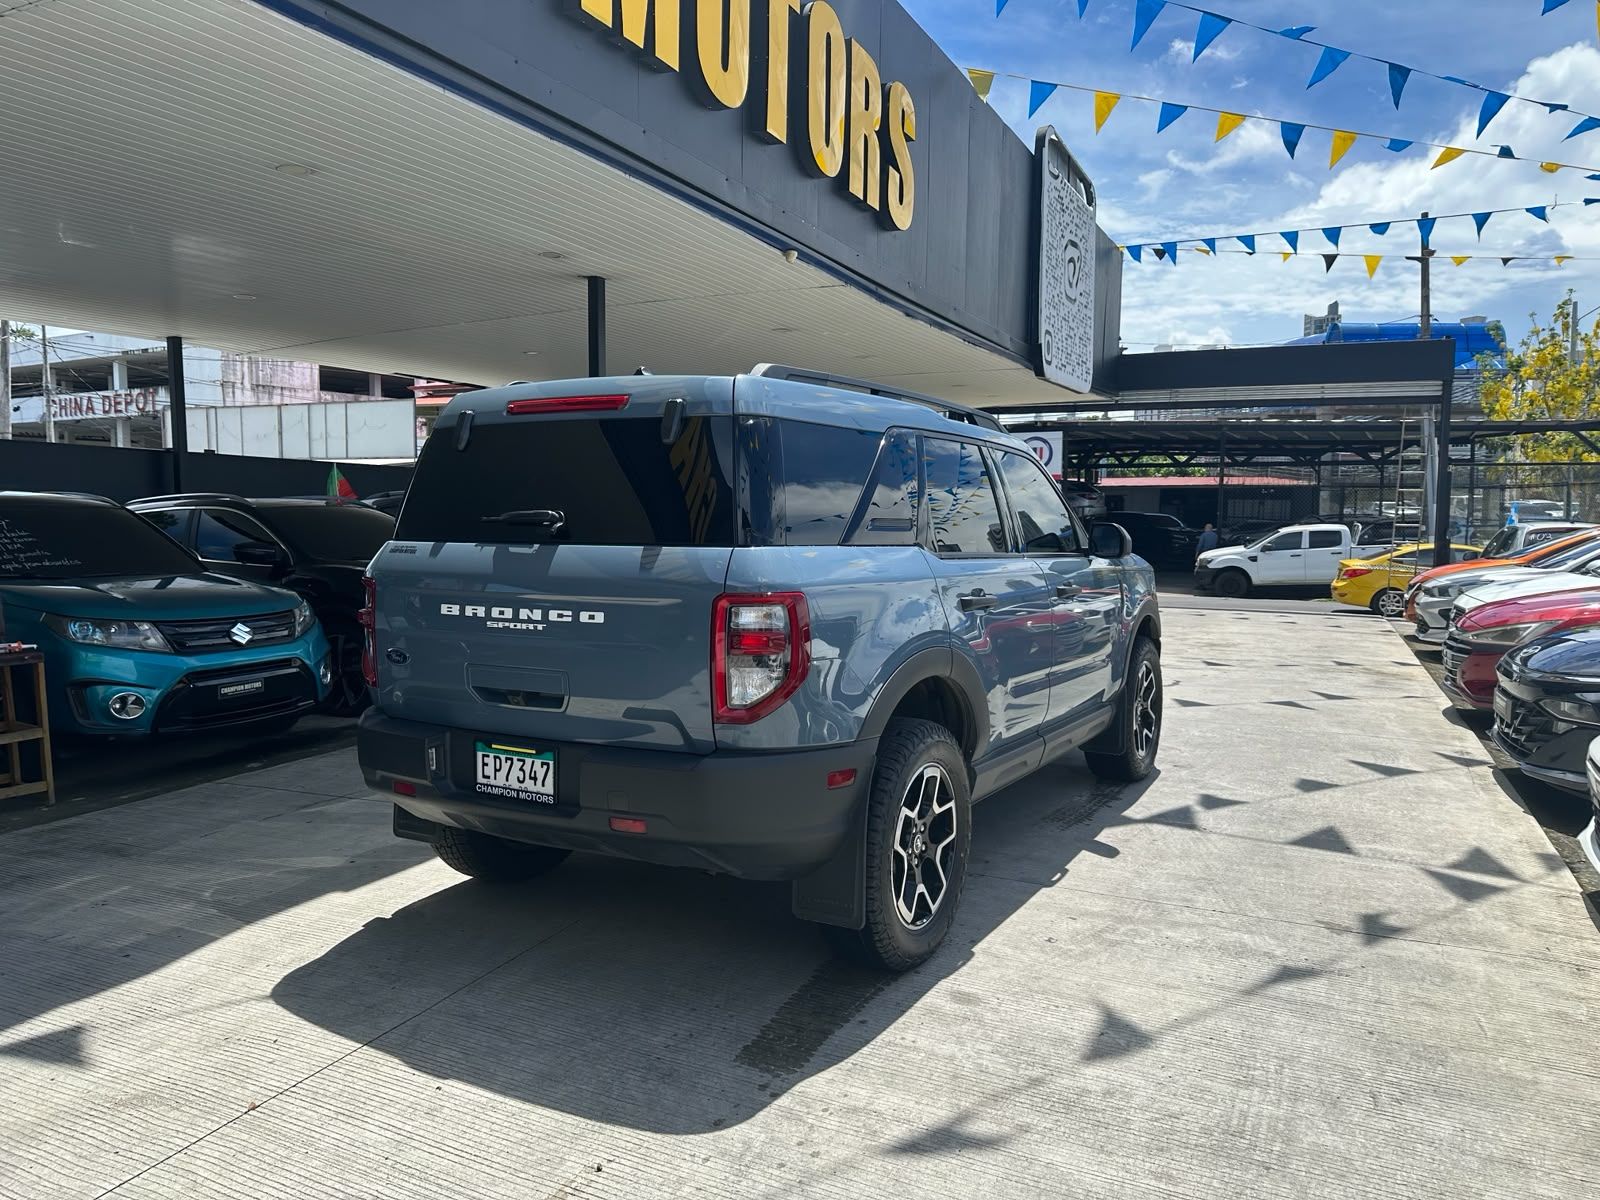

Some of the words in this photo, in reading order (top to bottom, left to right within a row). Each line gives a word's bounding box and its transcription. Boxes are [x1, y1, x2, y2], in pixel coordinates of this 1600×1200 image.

[578, 0, 916, 231] OTORS
[102, 387, 157, 415] DEPOT
[440, 603, 605, 624] BRONCO
[486, 621, 547, 631] SPORT
[481, 753, 551, 788] EP7347
[475, 784, 518, 798] CHAMPION
[519, 791, 554, 805] MOTORS
